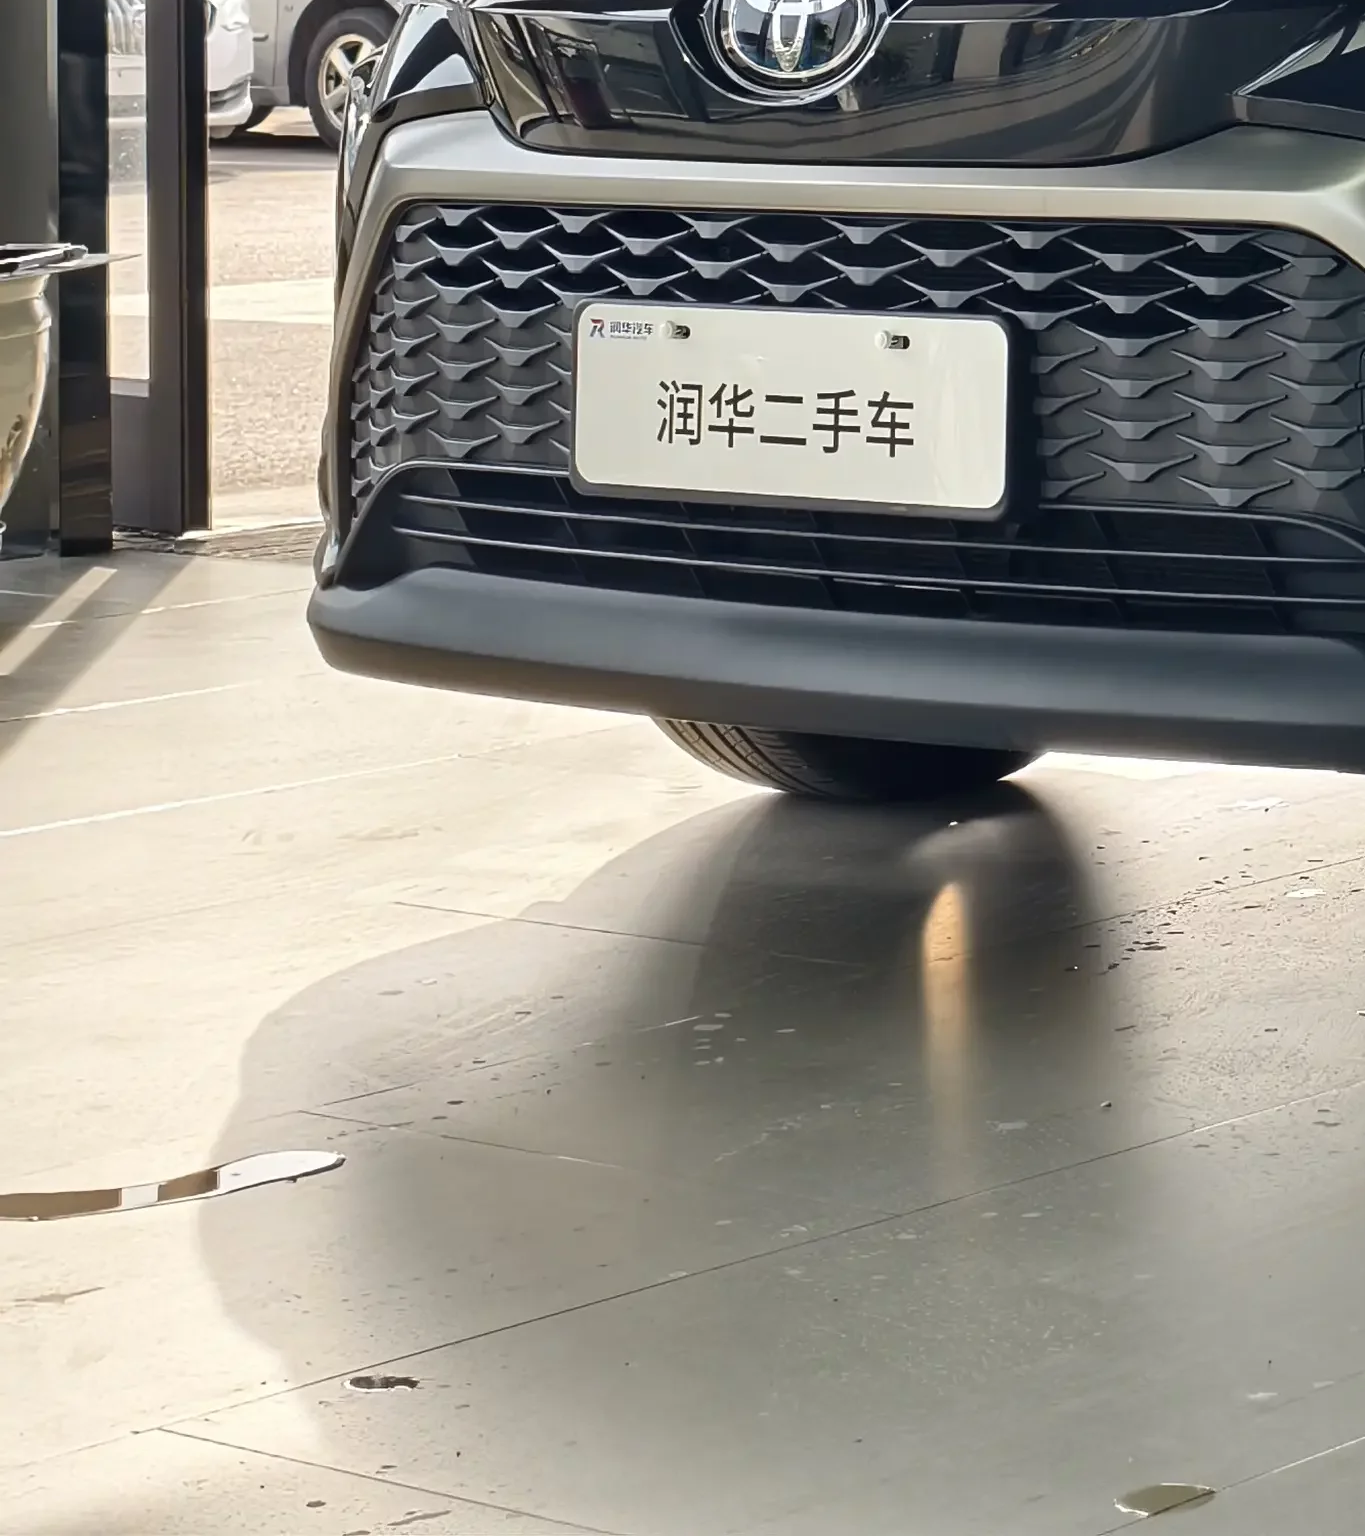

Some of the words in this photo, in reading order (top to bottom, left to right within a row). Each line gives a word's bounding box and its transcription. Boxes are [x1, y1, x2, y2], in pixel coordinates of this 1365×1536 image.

[656, 380, 914, 458] 润华二手车
